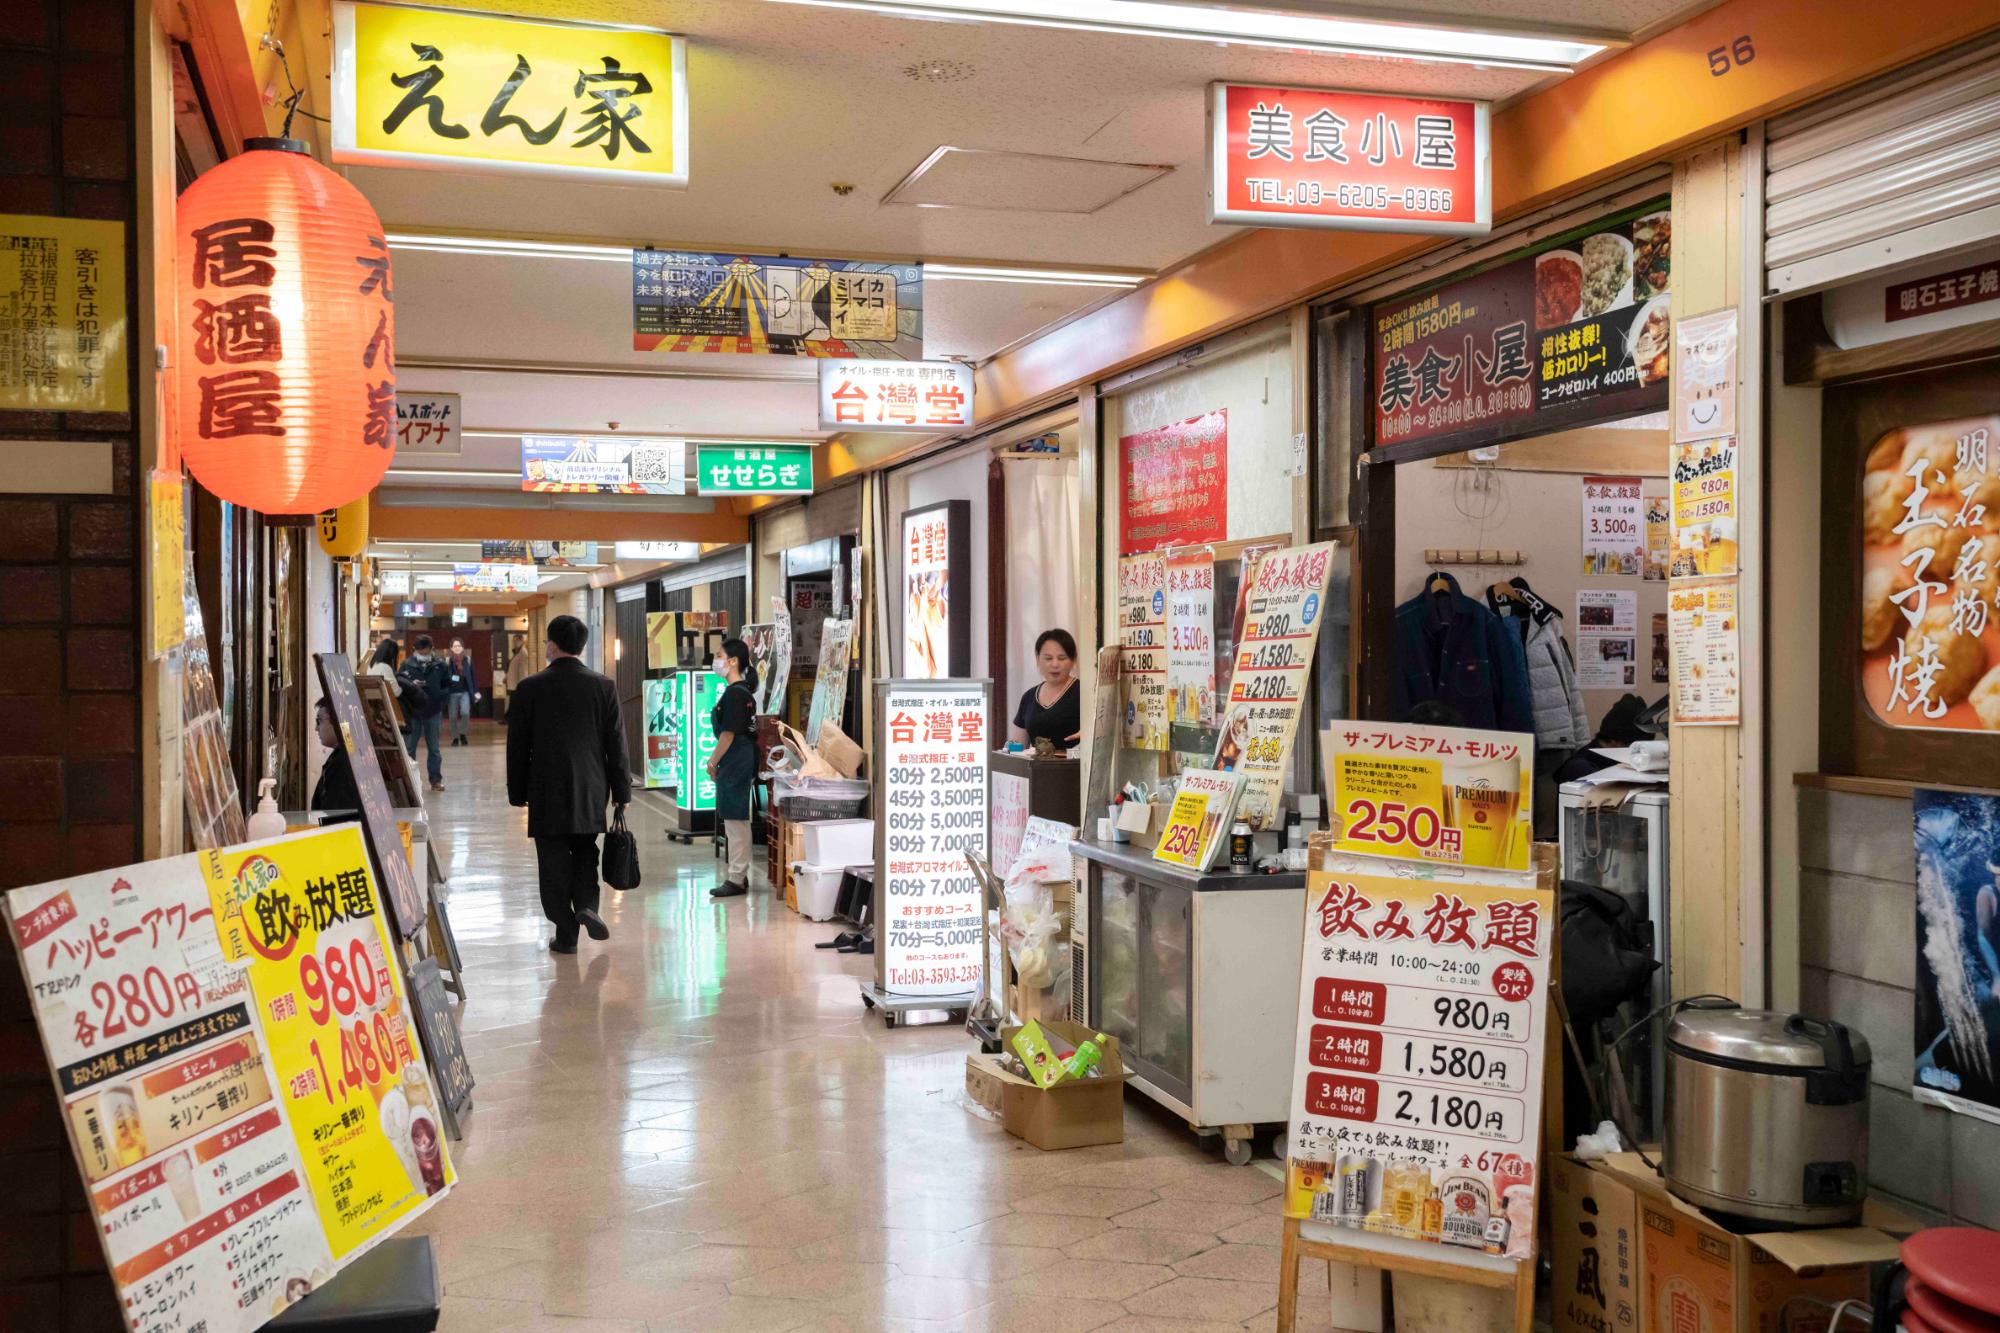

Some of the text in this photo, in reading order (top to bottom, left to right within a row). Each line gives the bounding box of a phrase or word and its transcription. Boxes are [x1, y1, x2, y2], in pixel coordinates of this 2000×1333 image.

[1707, 34, 1757, 78] 56
[383, 42, 653, 161] えん家
[1248, 103, 1457, 170] 美食小屋
[1245, 179, 1453, 213] TEL:03-6205-8366
[636, 285, 700, 298] 未来を描く
[852, 277, 868, 308] イマ
[870, 278, 884, 309] カコ
[1899, 268, 2000, 312] 明石玉子焼
[74, 247, 101, 390] 客引きは犯罪です
[193, 218, 287, 440] 居酒屋
[1541, 323, 1601, 358] 相性抜群!
[1378, 320, 1534, 414] 美食小屋
[1541, 346, 1607, 383] 低カロリー!
[1541, 377, 1599, 401] コークゼロハイ
[396, 421, 451, 445] イアナ
[733, 448, 777, 461] 居酒屋
[709, 463, 801, 488] せせらぎ
[1590, 518, 1637, 535] 3,500円
[1949, 427, 1988, 638] 明石名物
[1257, 548, 1330, 594] 飲み放題
[1172, 626, 1209, 653] 3,500円
[1258, 613, 1291, 638] ¥980
[1343, 731, 1519, 761] ザ・プレミアム・モルツ
[889, 766, 984, 786] 30分 2,500円
[889, 789, 984, 809] 45分 3,500円
[1455, 784, 1507, 804] PREMIUM
[889, 811, 984, 831] 60分 5,000円
[1347, 799, 1463, 852] 250円
[889, 834, 984, 854] 90分 7,000円
[1163, 823, 1200, 858] 250円
[233, 860, 278, 902] えん家の
[889, 877, 983, 897] 60分 7,000円
[255, 867, 376, 948] 飲み放題
[902, 903, 974, 916] おすすめコース
[1317, 881, 1540, 958] 飲み放題
[47, 902, 212, 970] ハッピーアワー
[1321, 947, 1378, 966] 営業時間
[299, 938, 394, 1027] 980円
[1501, 967, 1527, 983] 喫煙
[1330, 988, 1510, 1031] 1時間 980円
[180, 1057, 217, 1082] 生ビール
[309, 1011, 414, 1106] 1,480円
[1324, 1036, 1507, 1081] 2時間 1,580円
[168, 1081, 249, 1131] キリン一番搾り
[1321, 1083, 1504, 1131] 3時間 2,180円
[313, 1105, 366, 1143] キリン一番搾り
[1299, 1121, 1450, 1156] 昼でも夜でも飲み放題!!
[111, 1170, 158, 1203] ハイボール
[113, 1196, 163, 1231] ハイボール
[1443, 1221, 1483, 1237] BOURBON
[232, 1233, 280, 1269] ライムサワー
[133, 1263, 195, 1305] レモンサワー
[238, 1251, 285, 1289] ライチサワー
[138, 1281, 196, 1326] ウーロンハイ
